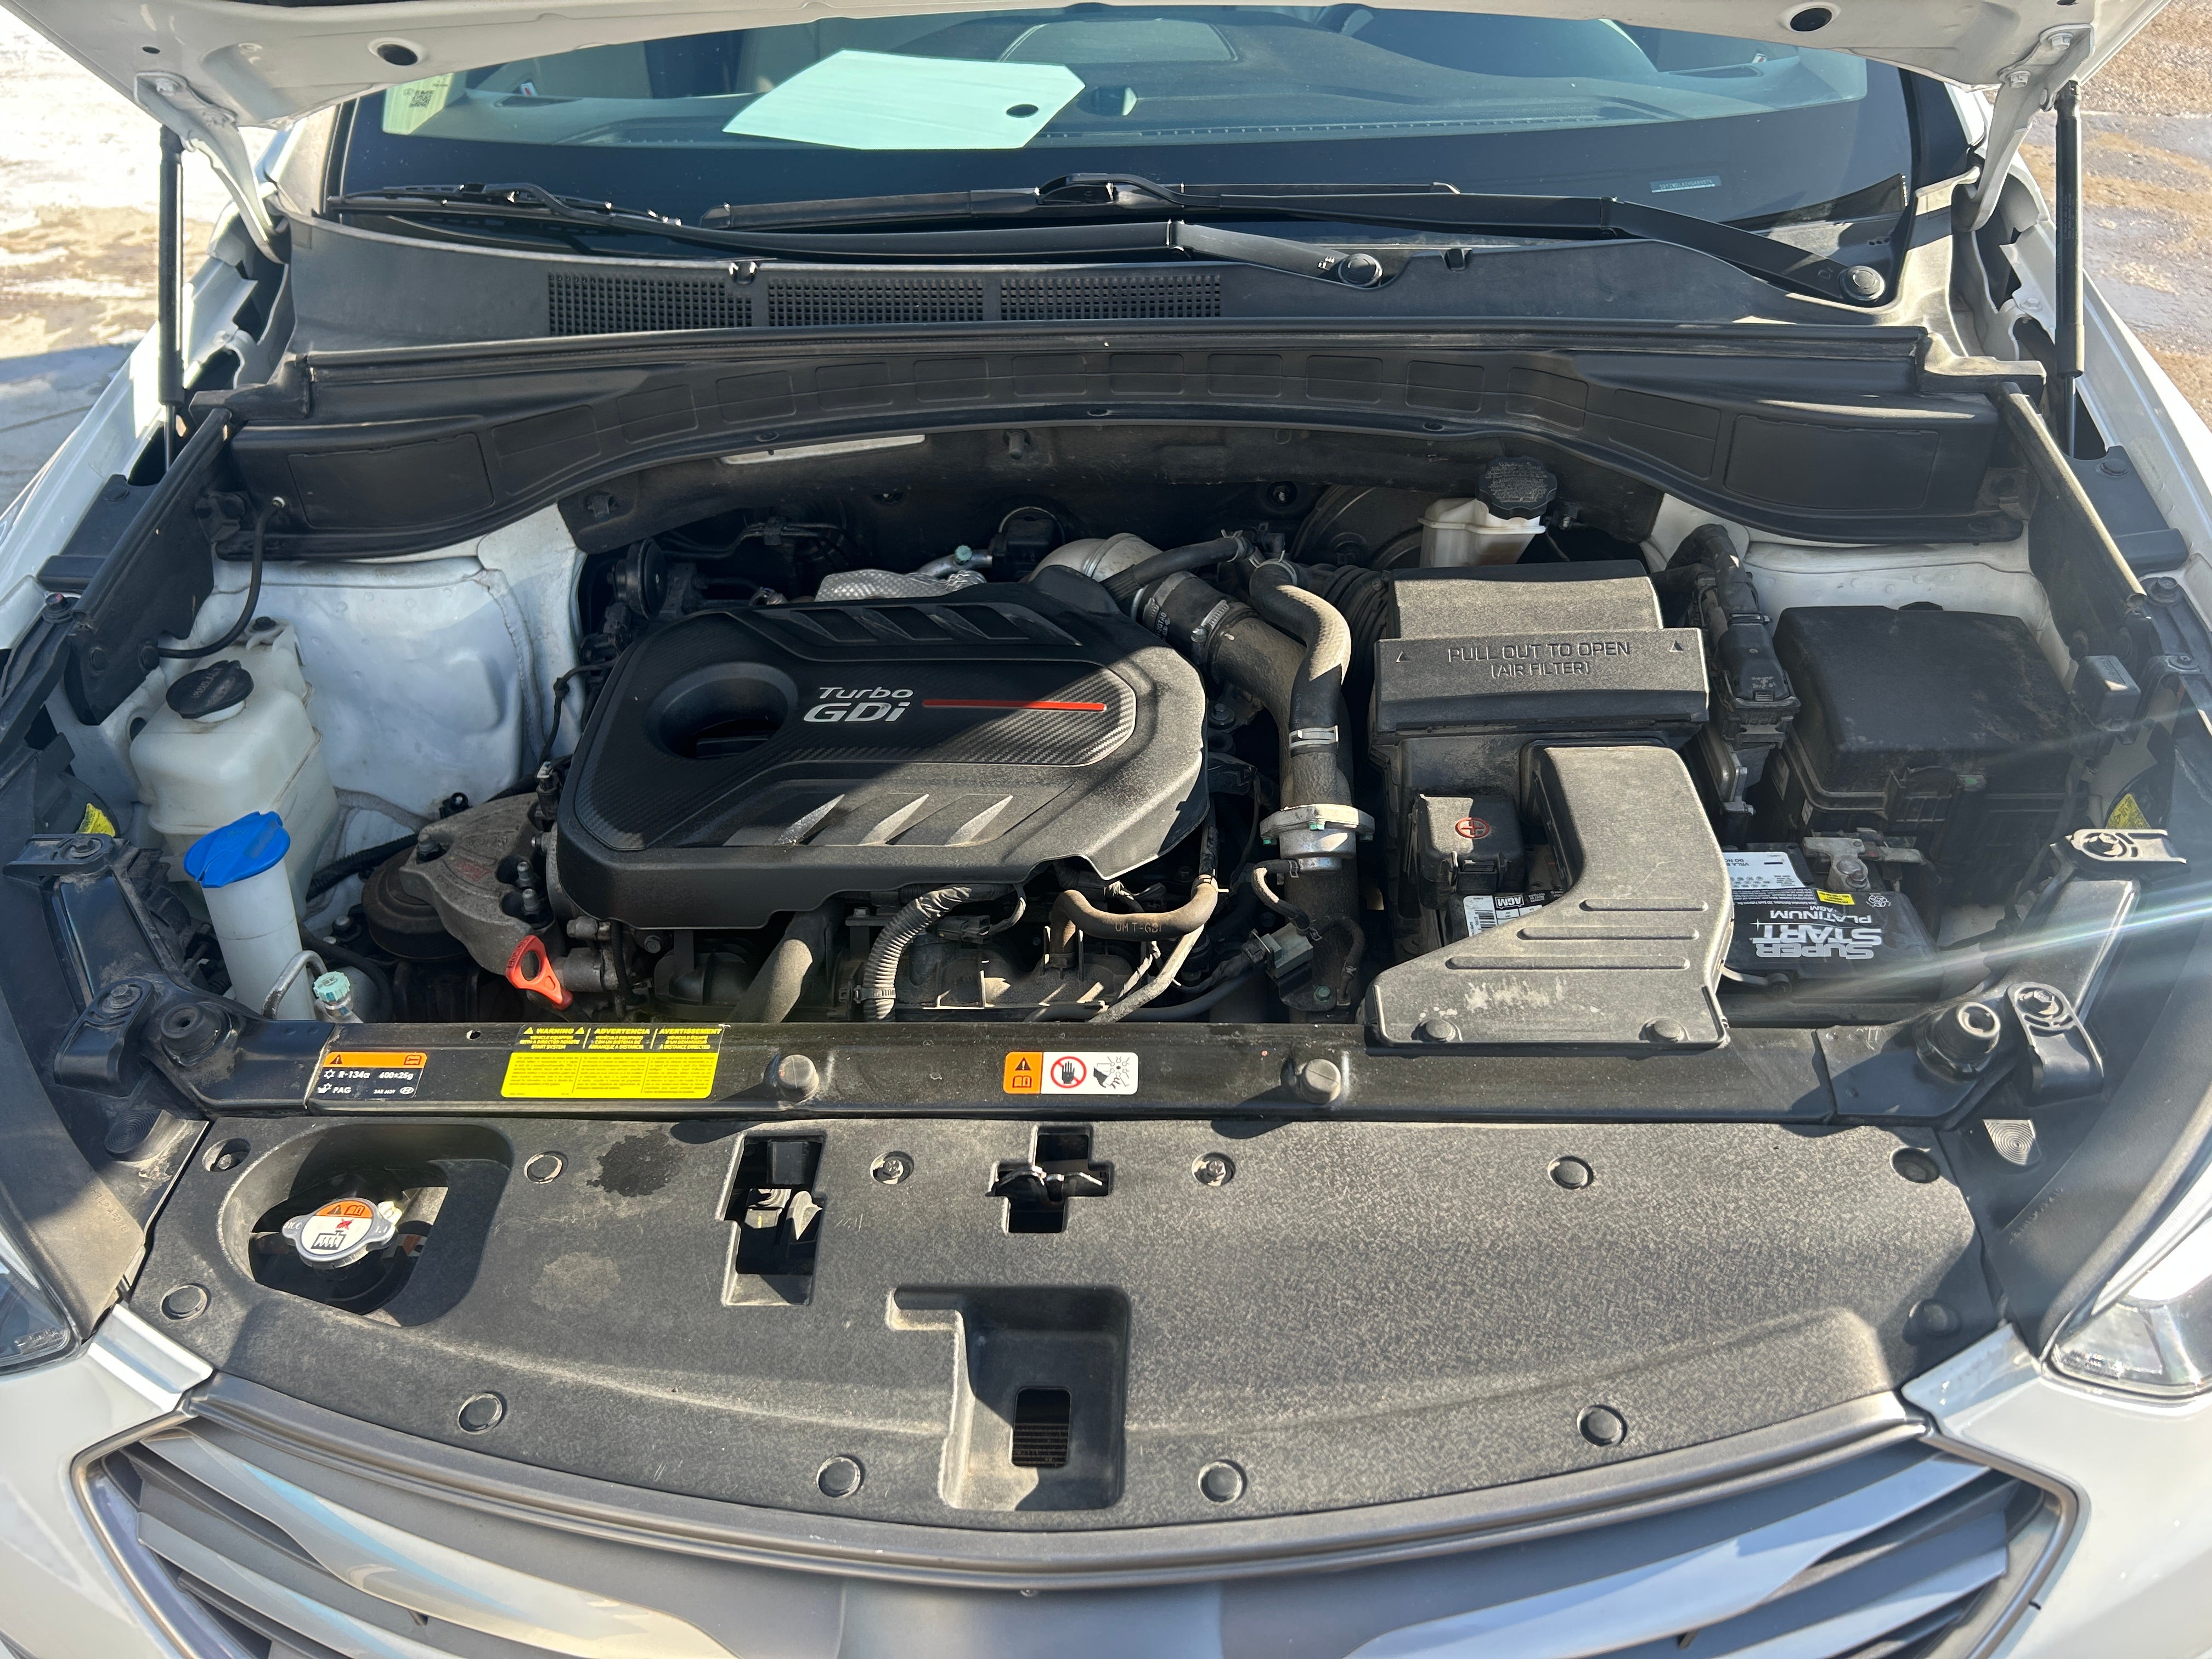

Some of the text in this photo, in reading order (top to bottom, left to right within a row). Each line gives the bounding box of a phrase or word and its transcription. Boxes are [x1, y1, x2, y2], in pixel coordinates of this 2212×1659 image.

[1448, 642, 1631, 663] PULL OUT TO OPEN
[1491, 661, 1591, 679] (AIR FILTER)
[819, 687, 914, 699] Turbo
[803, 702, 911, 722] GDi
[1497, 896, 1521, 906] AGM
[1770, 910, 1872, 923] PLATINUM
[1752, 925, 1882, 946] START
[1756, 943, 1874, 960] SUPER
[338, 1070, 414, 1080] R-134a 600±25g
